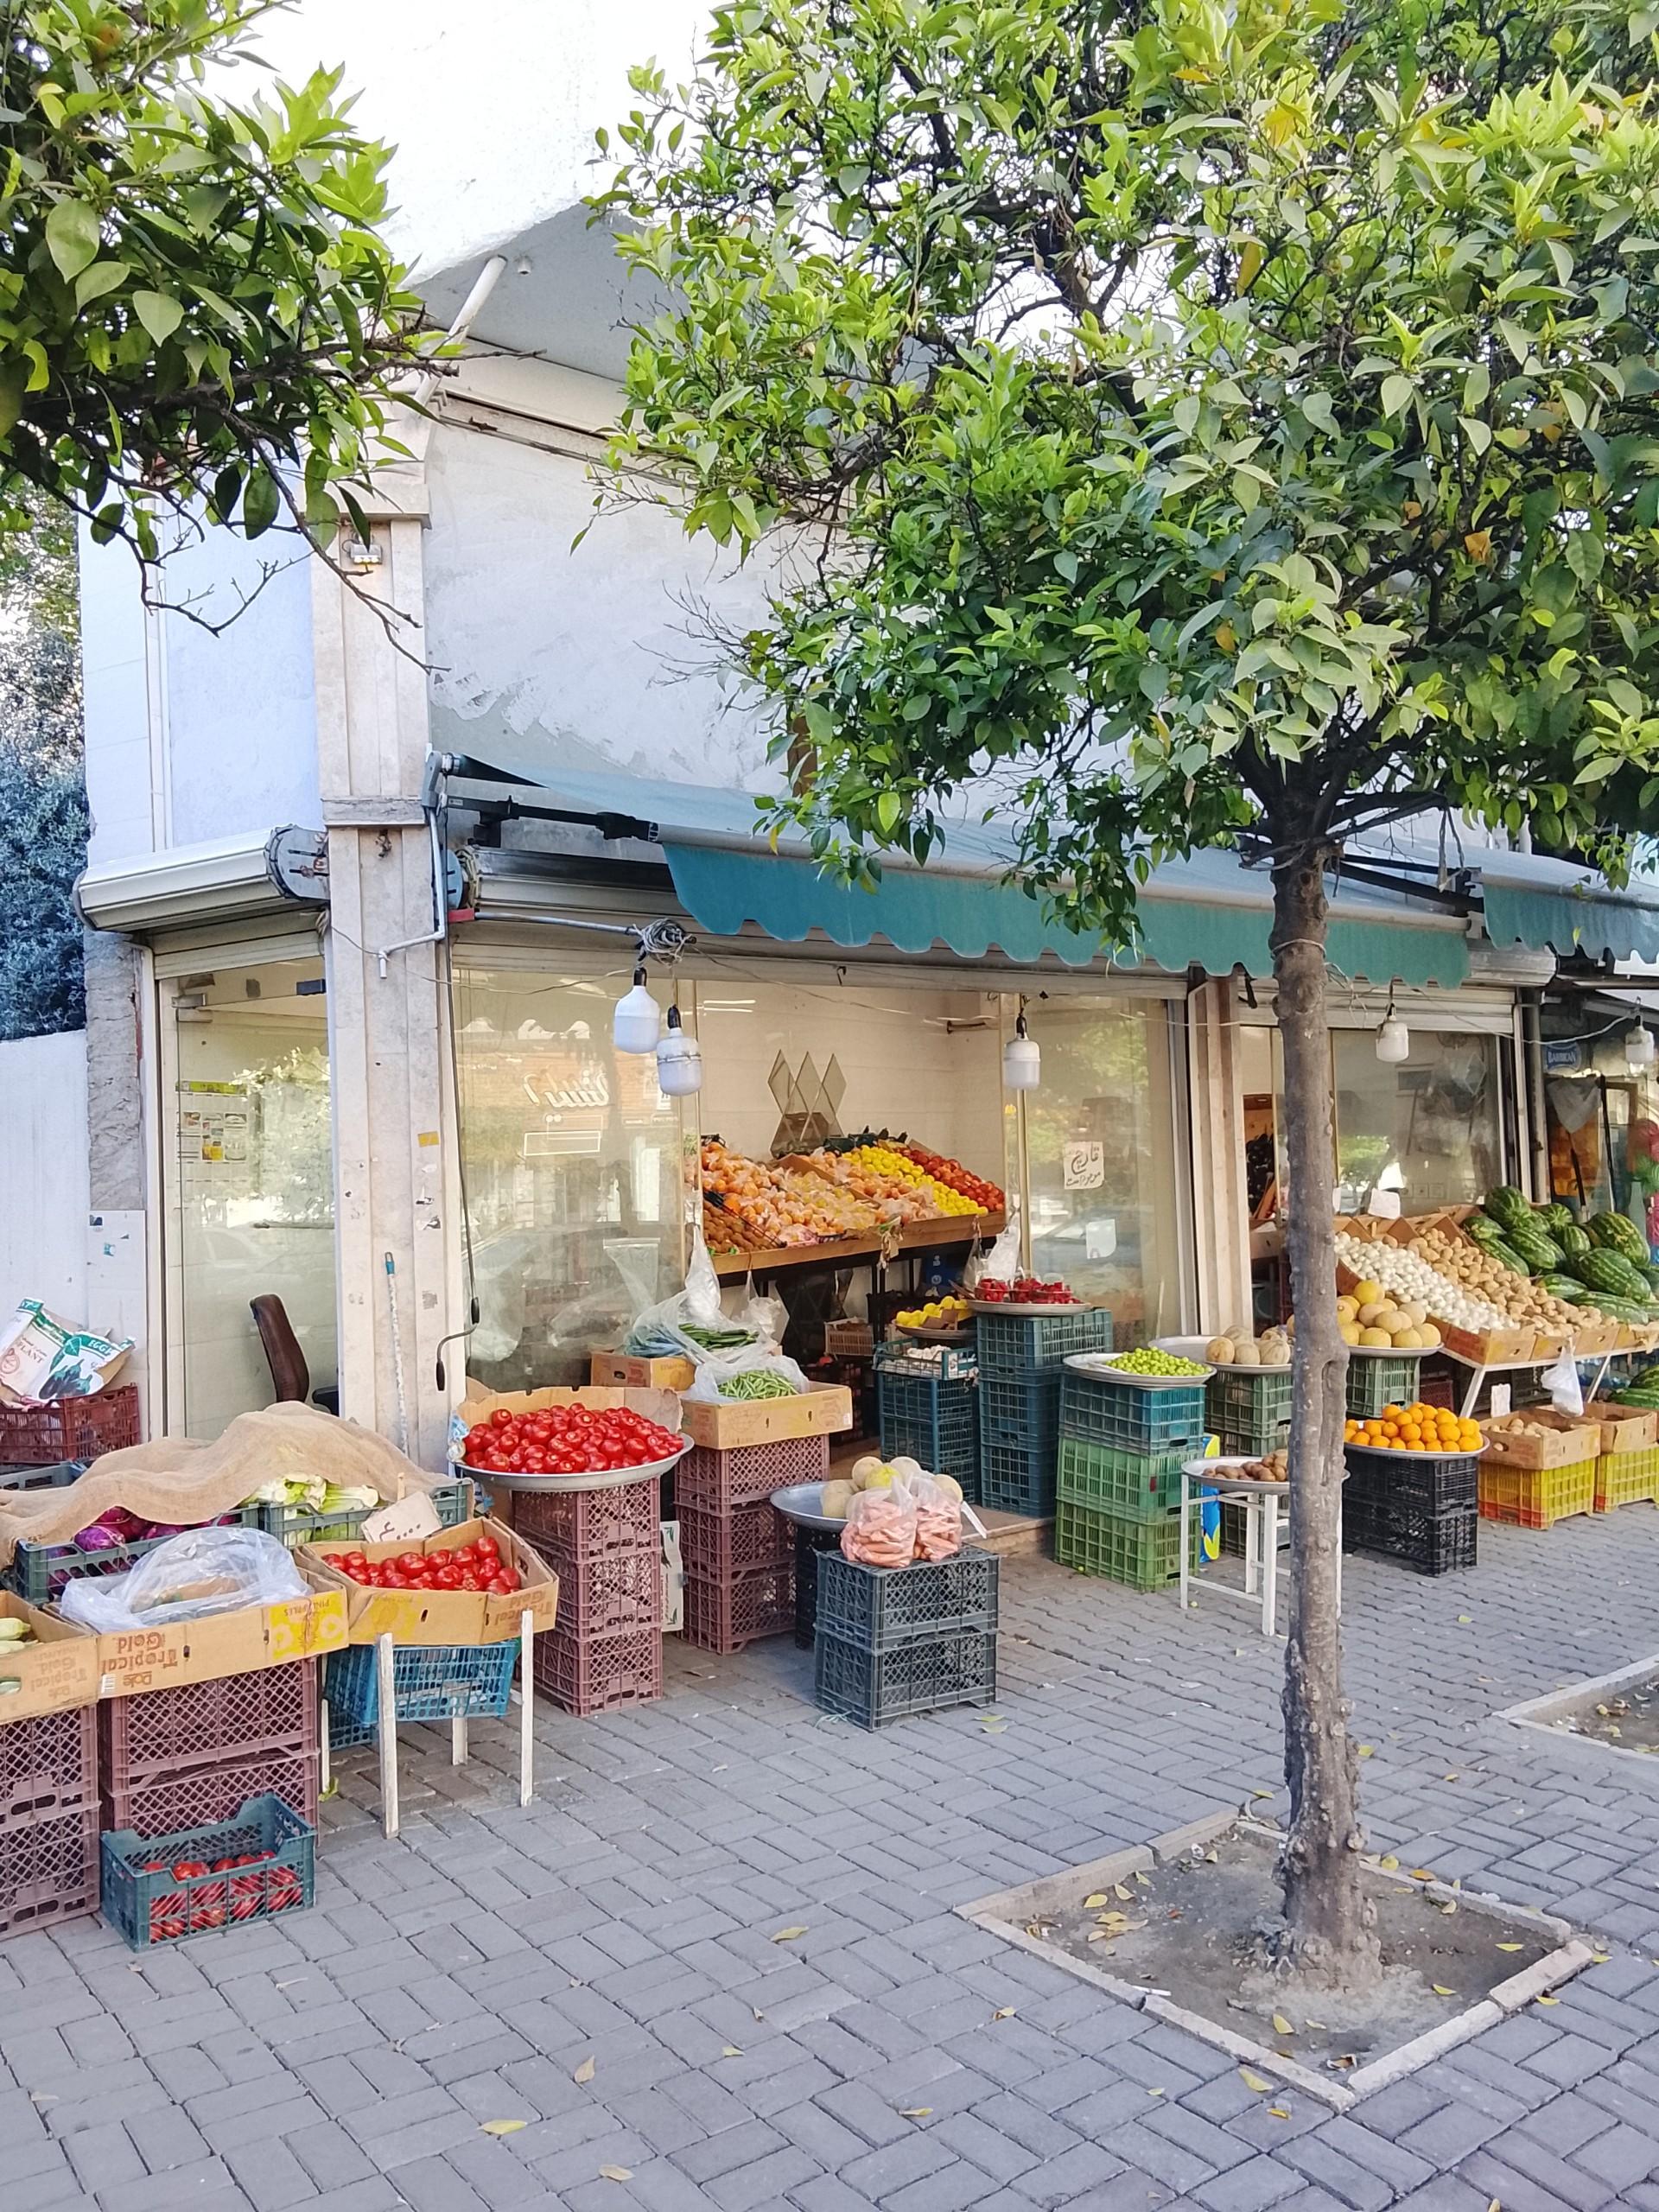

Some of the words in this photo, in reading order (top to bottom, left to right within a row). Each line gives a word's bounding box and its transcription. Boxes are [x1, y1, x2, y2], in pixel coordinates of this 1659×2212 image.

[118, 1631, 164, 1655] Gold
[101, 1649, 178, 1676] Tropical
[123, 1670, 153, 1688] Dole
